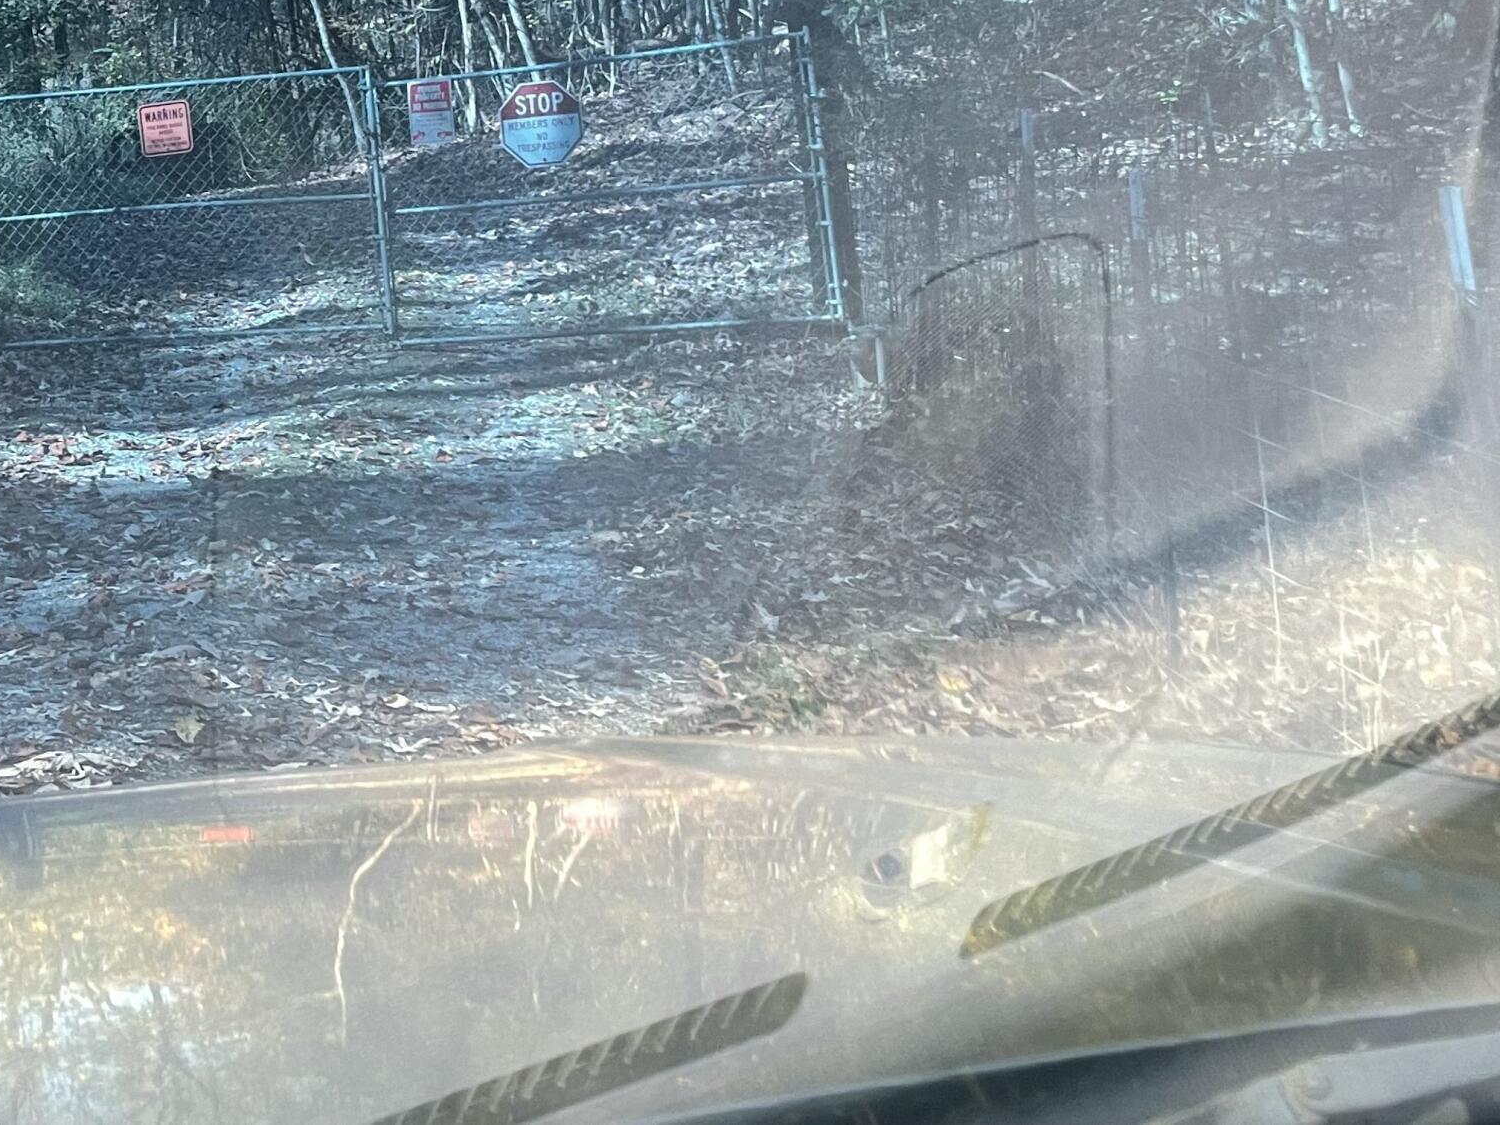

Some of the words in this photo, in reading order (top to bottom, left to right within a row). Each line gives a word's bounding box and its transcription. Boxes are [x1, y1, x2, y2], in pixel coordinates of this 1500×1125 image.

[514, 91, 564, 116] STOP
[144, 107, 184, 123] WARNING
[507, 118, 548, 131] MEMBERS
[551, 115, 575, 127] ONLY
[536, 132, 549, 141] NO
[517, 140, 571, 152] TRESPASSING
